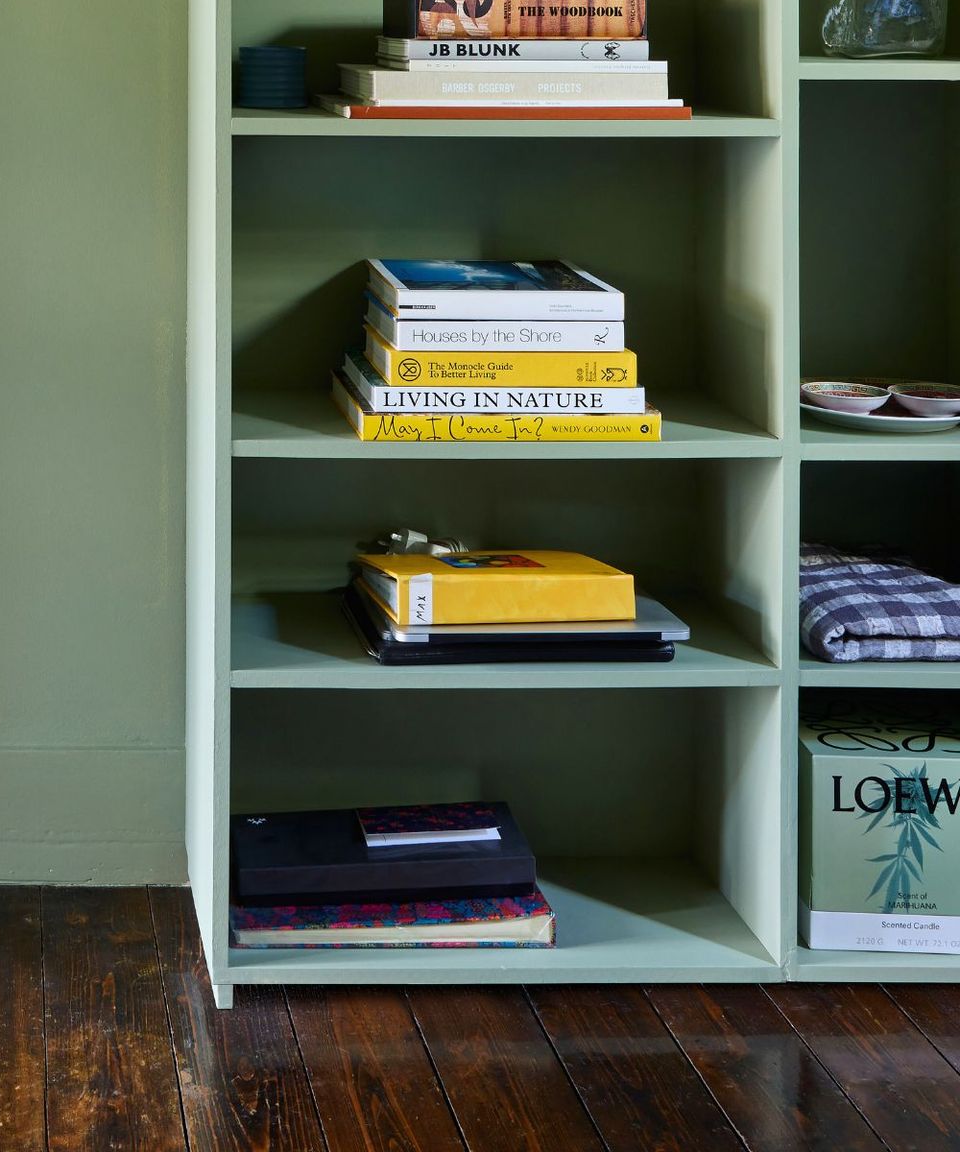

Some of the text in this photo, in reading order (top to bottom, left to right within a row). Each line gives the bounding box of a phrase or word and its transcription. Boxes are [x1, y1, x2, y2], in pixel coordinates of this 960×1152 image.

[518, 6, 623, 17] THE WOODBOOK
[429, 43, 521, 57] JB BLUNK
[442, 82, 474, 93] BARBER
[537, 82, 582, 93] PROJECTS
[412, 329, 468, 343] Houses
[471, 328, 490, 346] by
[494, 329, 516, 343] the
[519, 328, 562, 343] Shore
[428, 362, 514, 371] The Monocle Guide
[428, 370, 497, 380] To Better Living
[383, 392, 604, 409] LIVING IN NATURE
[374, 415, 422, 440] May
[425, 417, 443, 440] I
[448, 415, 502, 440] Come
[505, 416, 544, 441] In?
[551, 425, 581, 434] WENDY
[583, 425, 632, 434] GOODMAN
[415, 594, 426, 622] MAX
[832, 775, 960, 815] LOEW
[898, 892, 928, 900] Scent of
[888, 901, 938, 910] MARIHUANA
[881, 920, 940, 930] Scented Candle
[856, 937, 876, 945] 2120
[897, 938, 912, 946] NET
